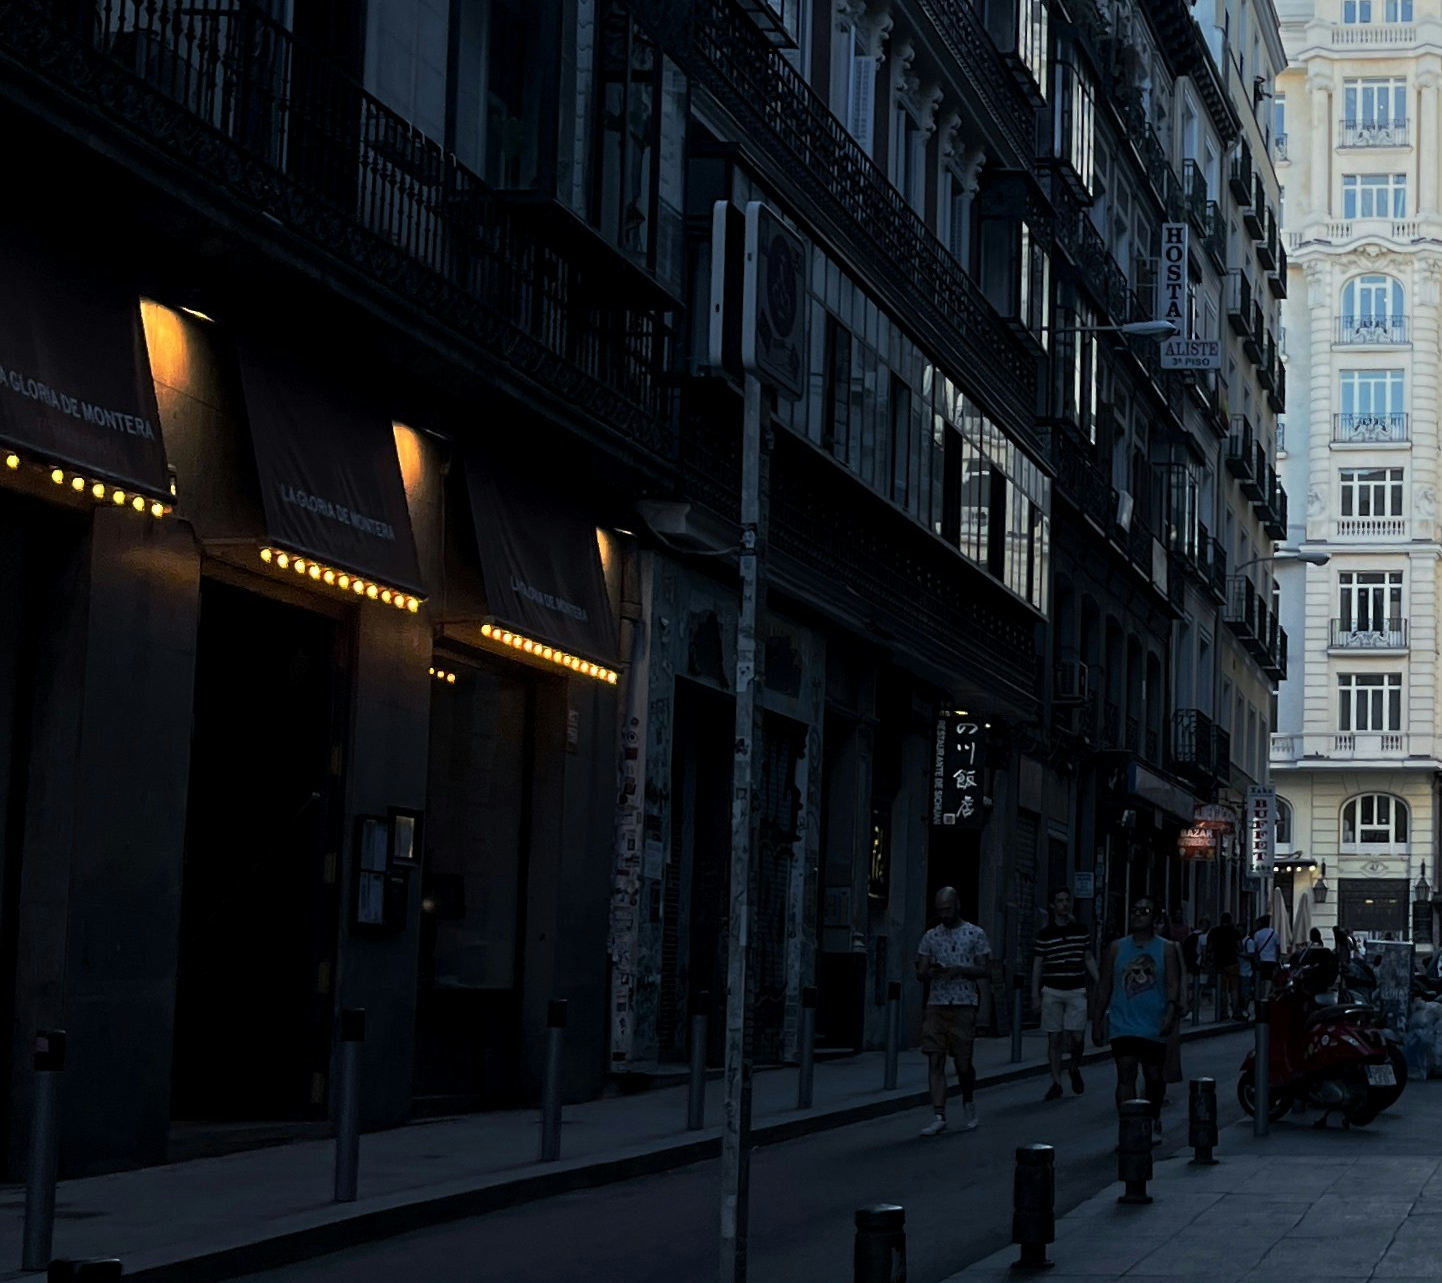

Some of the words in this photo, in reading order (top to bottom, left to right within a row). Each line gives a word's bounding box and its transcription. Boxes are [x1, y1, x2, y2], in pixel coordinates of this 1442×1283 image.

[1165, 342, 1218, 356] ALISTE
[1185, 357, 1210, 366] PISO
[9, 369, 61, 411] GLORIA
[60, 393, 82, 419] DE
[81, 400, 156, 441] MONTERA
[280, 483, 298, 505] LA
[335, 503, 352, 526] DE
[933, 777, 945, 789] DE
[1254, 799, 1268, 861] BUFFET
